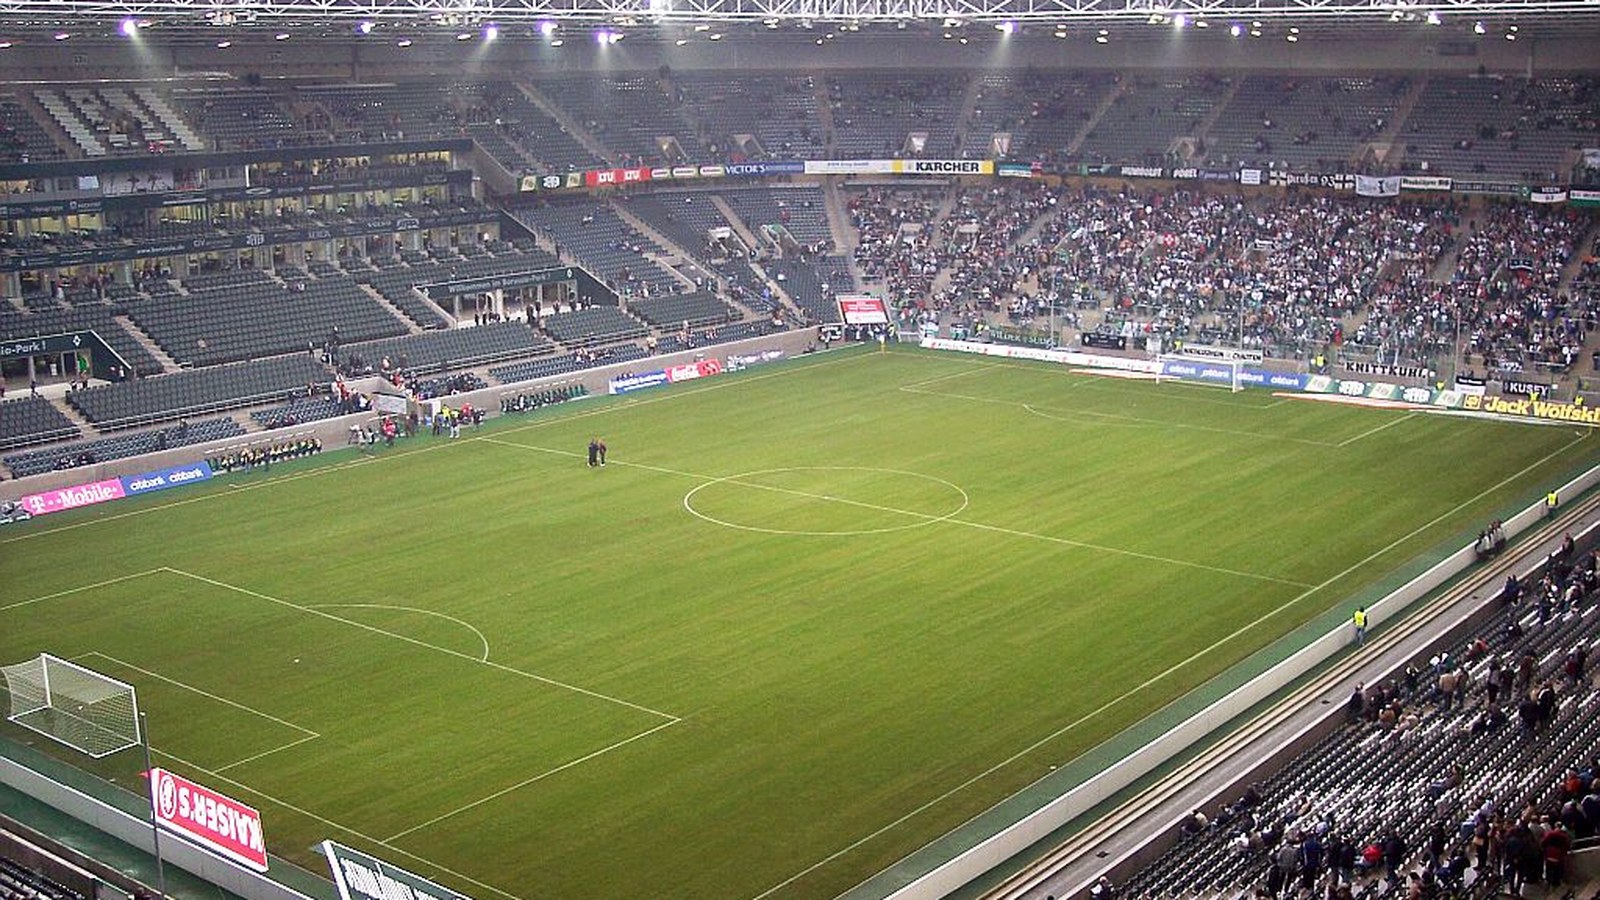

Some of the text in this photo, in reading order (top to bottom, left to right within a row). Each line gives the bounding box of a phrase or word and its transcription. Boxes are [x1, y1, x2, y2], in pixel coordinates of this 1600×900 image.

[1509, 382, 1548, 397] KUSEY
[1484, 396, 1529, 416] Jack
[130, 474, 166, 491] citibank
[169, 467, 204, 485] citibank
[178, 787, 264, 854] KAISER'S
